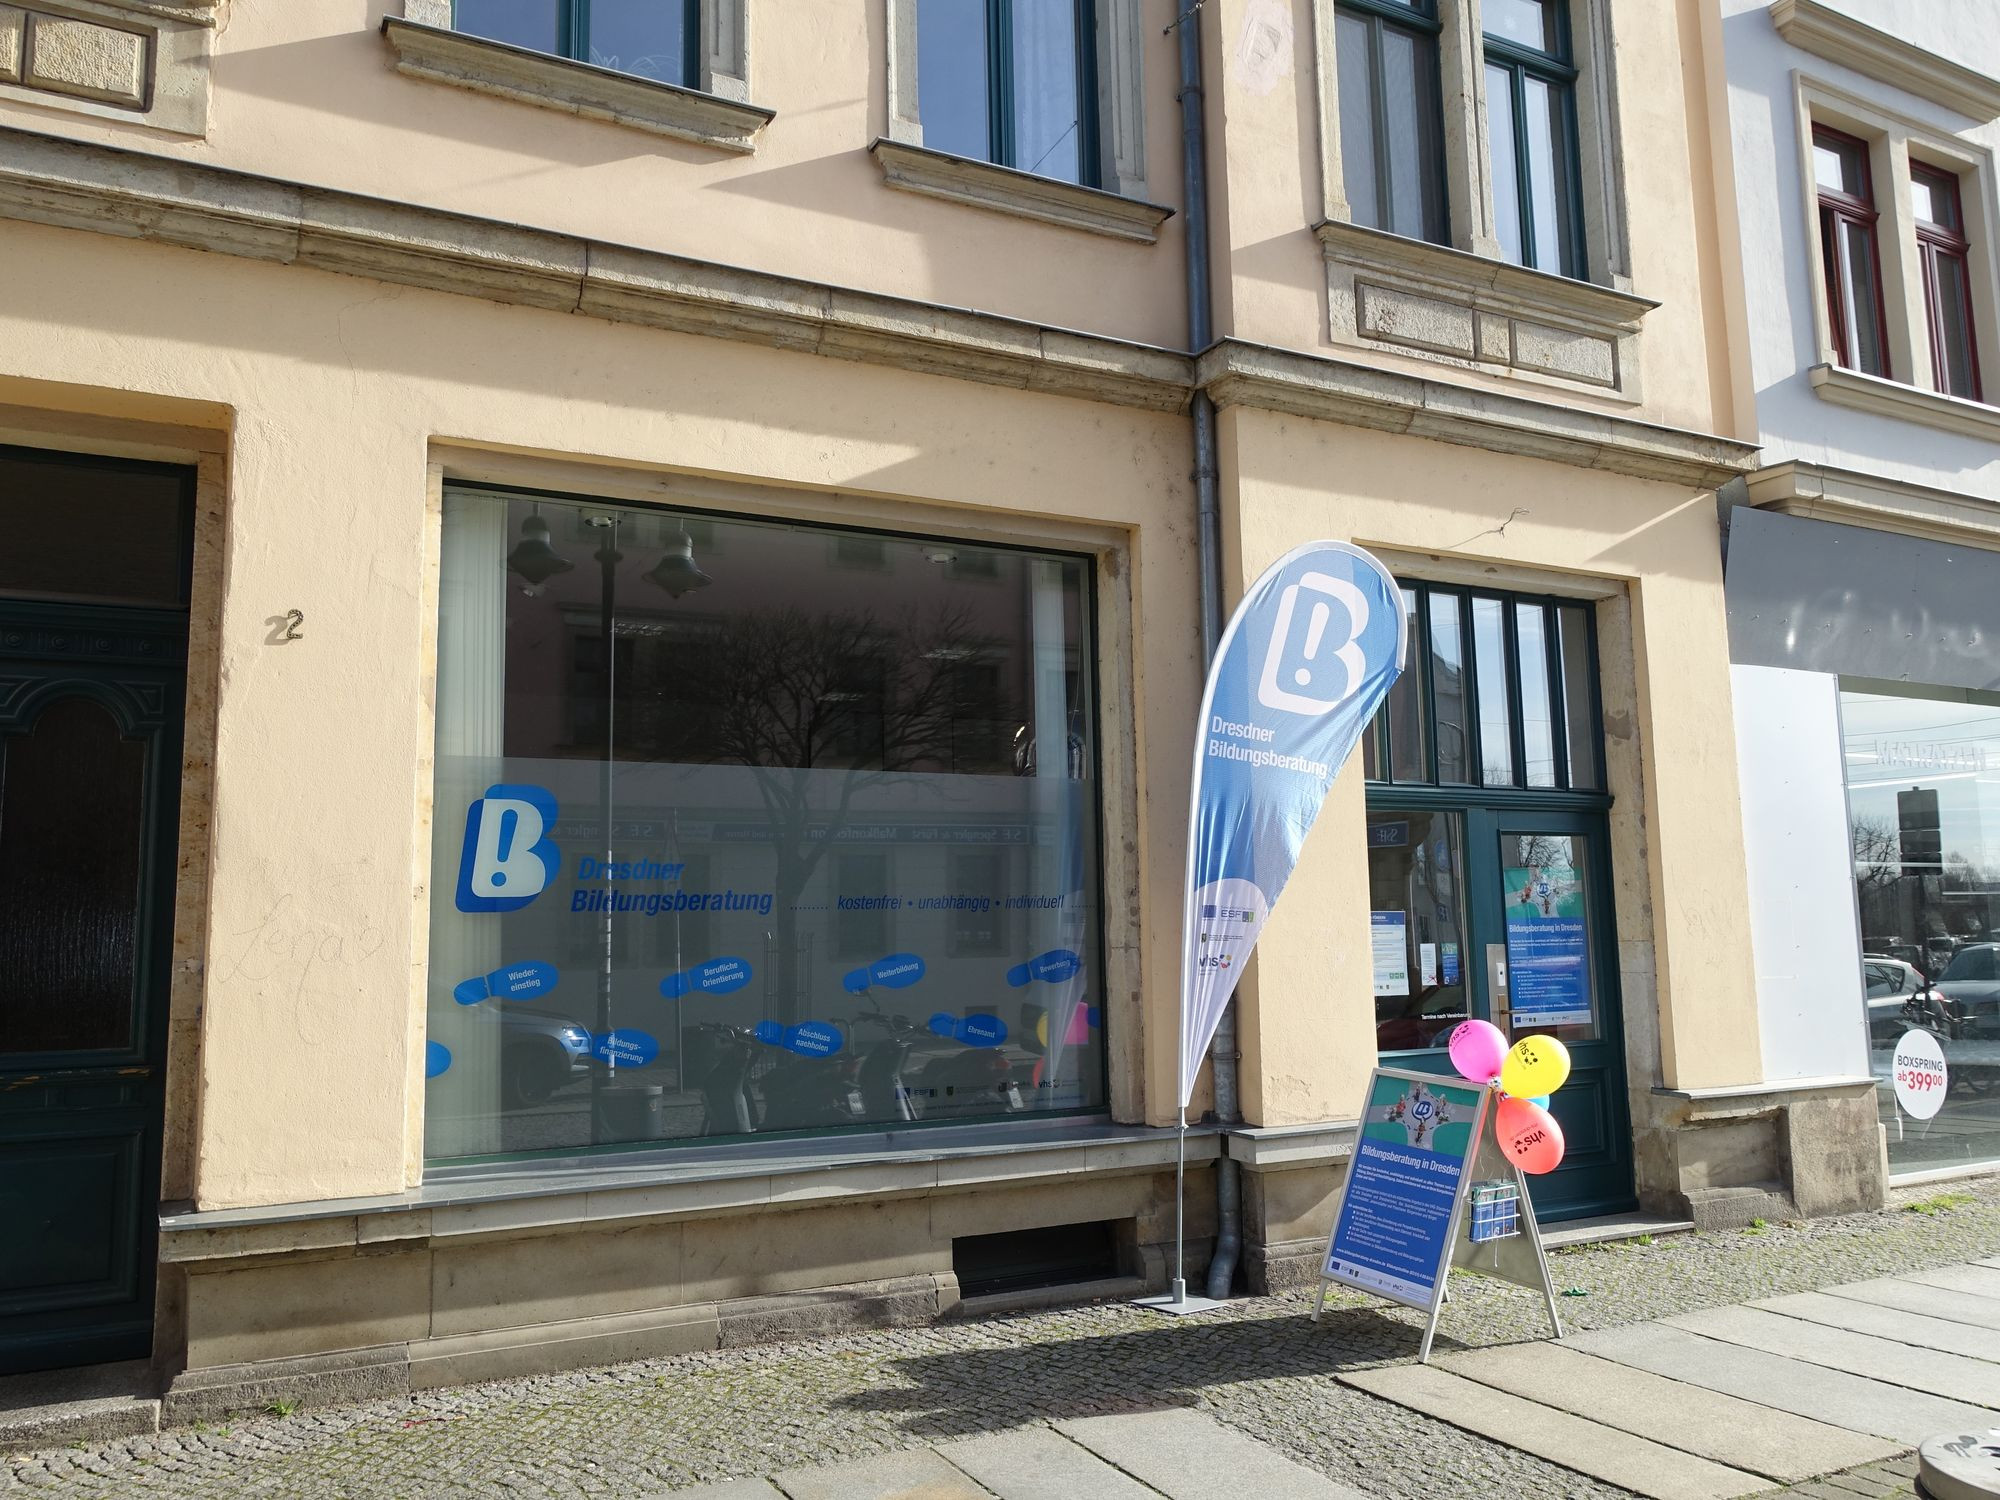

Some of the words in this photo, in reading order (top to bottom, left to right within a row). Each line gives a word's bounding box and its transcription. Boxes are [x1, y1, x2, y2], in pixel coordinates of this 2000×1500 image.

[286, 609, 304, 639] 2
[1212, 716, 1275, 743] Dresdner
[1208, 740, 1328, 779] Bildungsberatung
[577, 857, 685, 881] Dresdner
[571, 889, 773, 916] Bildungsberatung
[837, 894, 902, 910] kostenfrei
[918, 895, 990, 912] unabhängig
[1005, 894, 1064, 910] individuell
[1221, 909, 1242, 919] ESF
[1509, 924, 1555, 934] Bildungsberatung
[1555, 924, 1561, 932] in
[1561, 923, 1582, 932] Dresden
[1199, 954, 1219, 967] vhs
[508, 968, 538, 981] Wieder-
[704, 961, 738, 977] Berufliche
[877, 961, 919, 979] Weiterbildung
[510, 978, 541, 992] einstieg
[702, 970, 744, 988] Orientierung
[797, 1027, 831, 1042] Abschluss
[607, 1036, 641, 1050] Bildungs-
[796, 1038, 828, 1053] nachholen
[600, 1045, 643, 1064] finanzierung
[1898, 1055, 1942, 1071] BOXSPRING
[1897, 1070, 1907, 1082] ab
[1524, 1130, 1546, 1146] vhs
[1360, 1145, 1422, 1168] Bildungsberatung
[1421, 1158, 1430, 1168] in
[1429, 1160, 1461, 1176] Dresden
